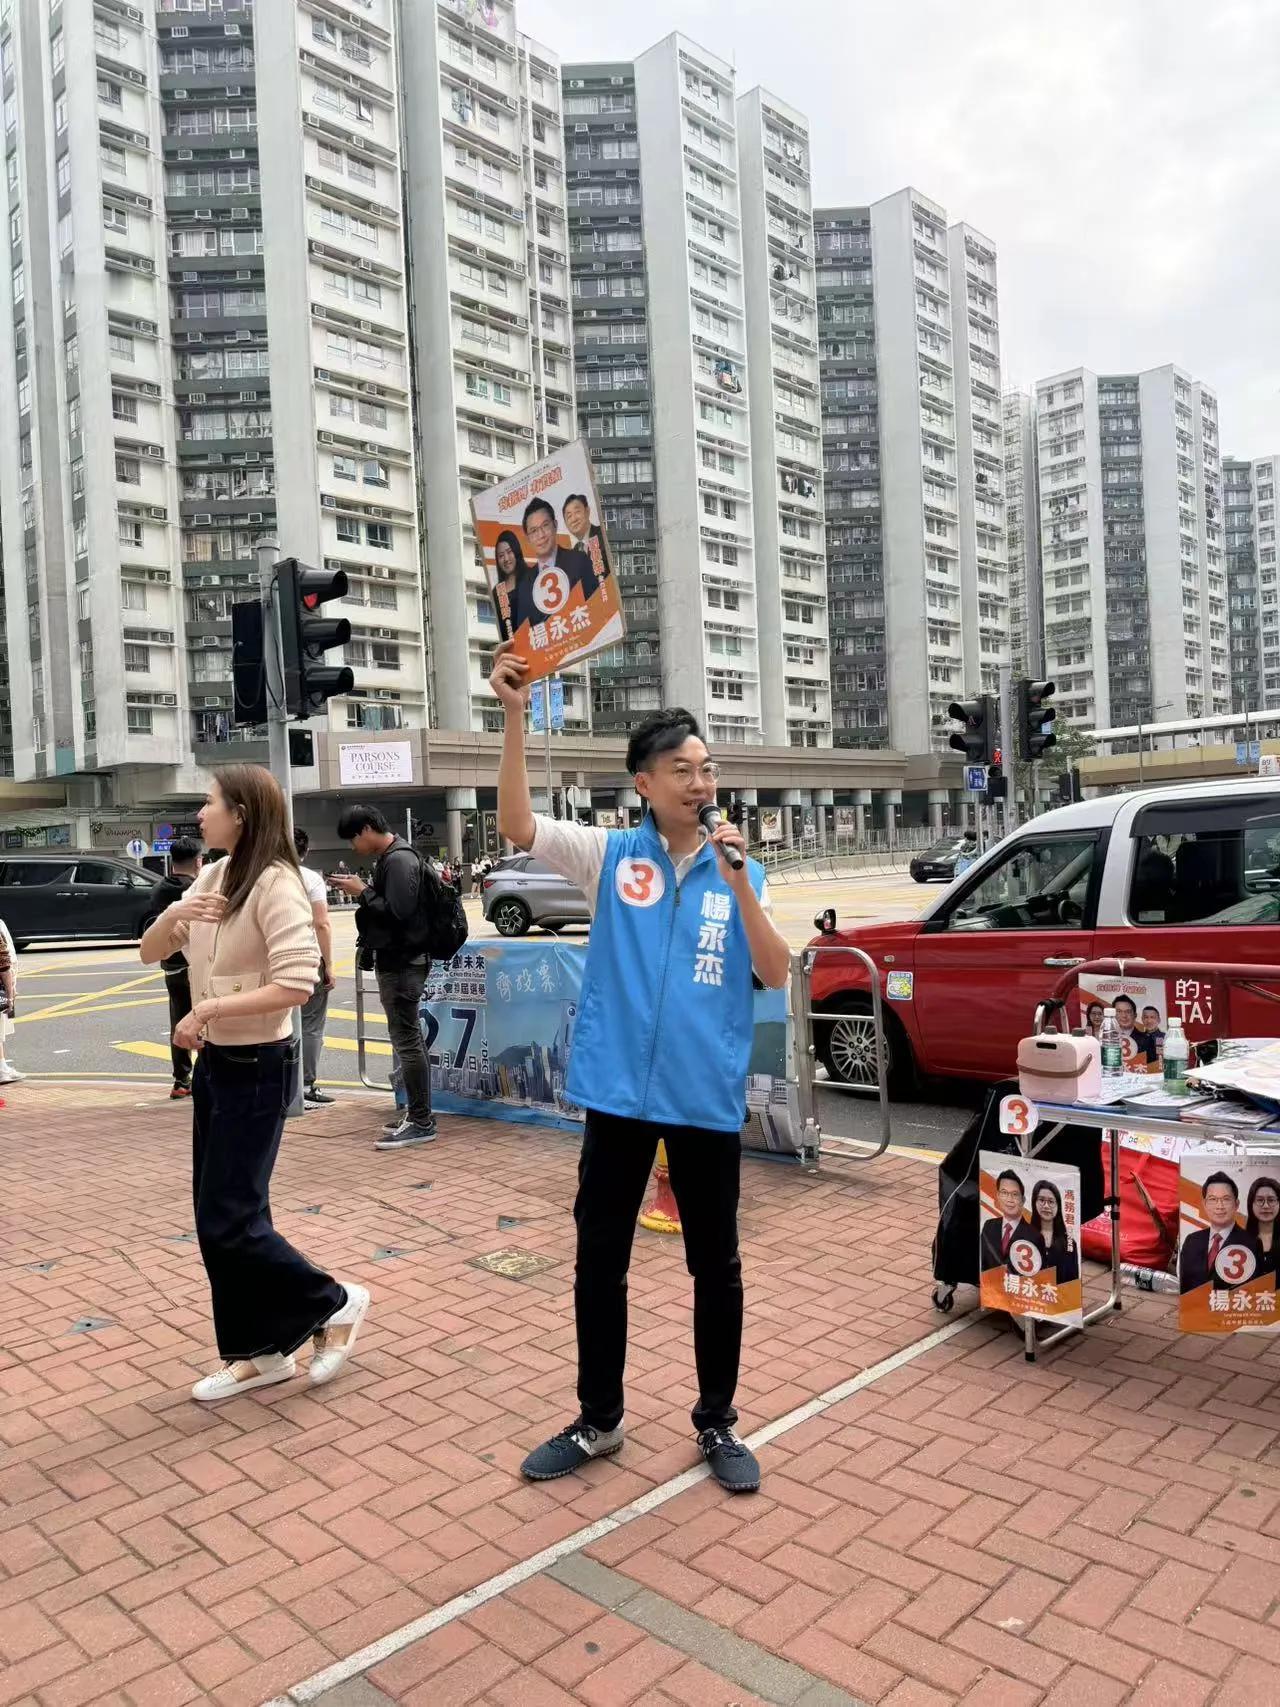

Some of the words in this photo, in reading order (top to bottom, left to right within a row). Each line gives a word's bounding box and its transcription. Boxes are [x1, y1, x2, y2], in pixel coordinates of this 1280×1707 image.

[540, 572, 563, 609] 3
[528, 604, 592, 651] 楊永杰
[351, 752, 400, 763] PARSONS
[355, 762, 396, 771] COURSE
[623, 863, 655, 901] 3
[693, 889, 732, 987] 楊永杰
[1007, 1099, 1029, 1133] 3
[1016, 1243, 1034, 1273] 3
[1223, 1247, 1248, 1280] 3
[1003, 1272, 1059, 1304] 楊永杰
[1208, 1289, 1277, 1313] 楊永杰
